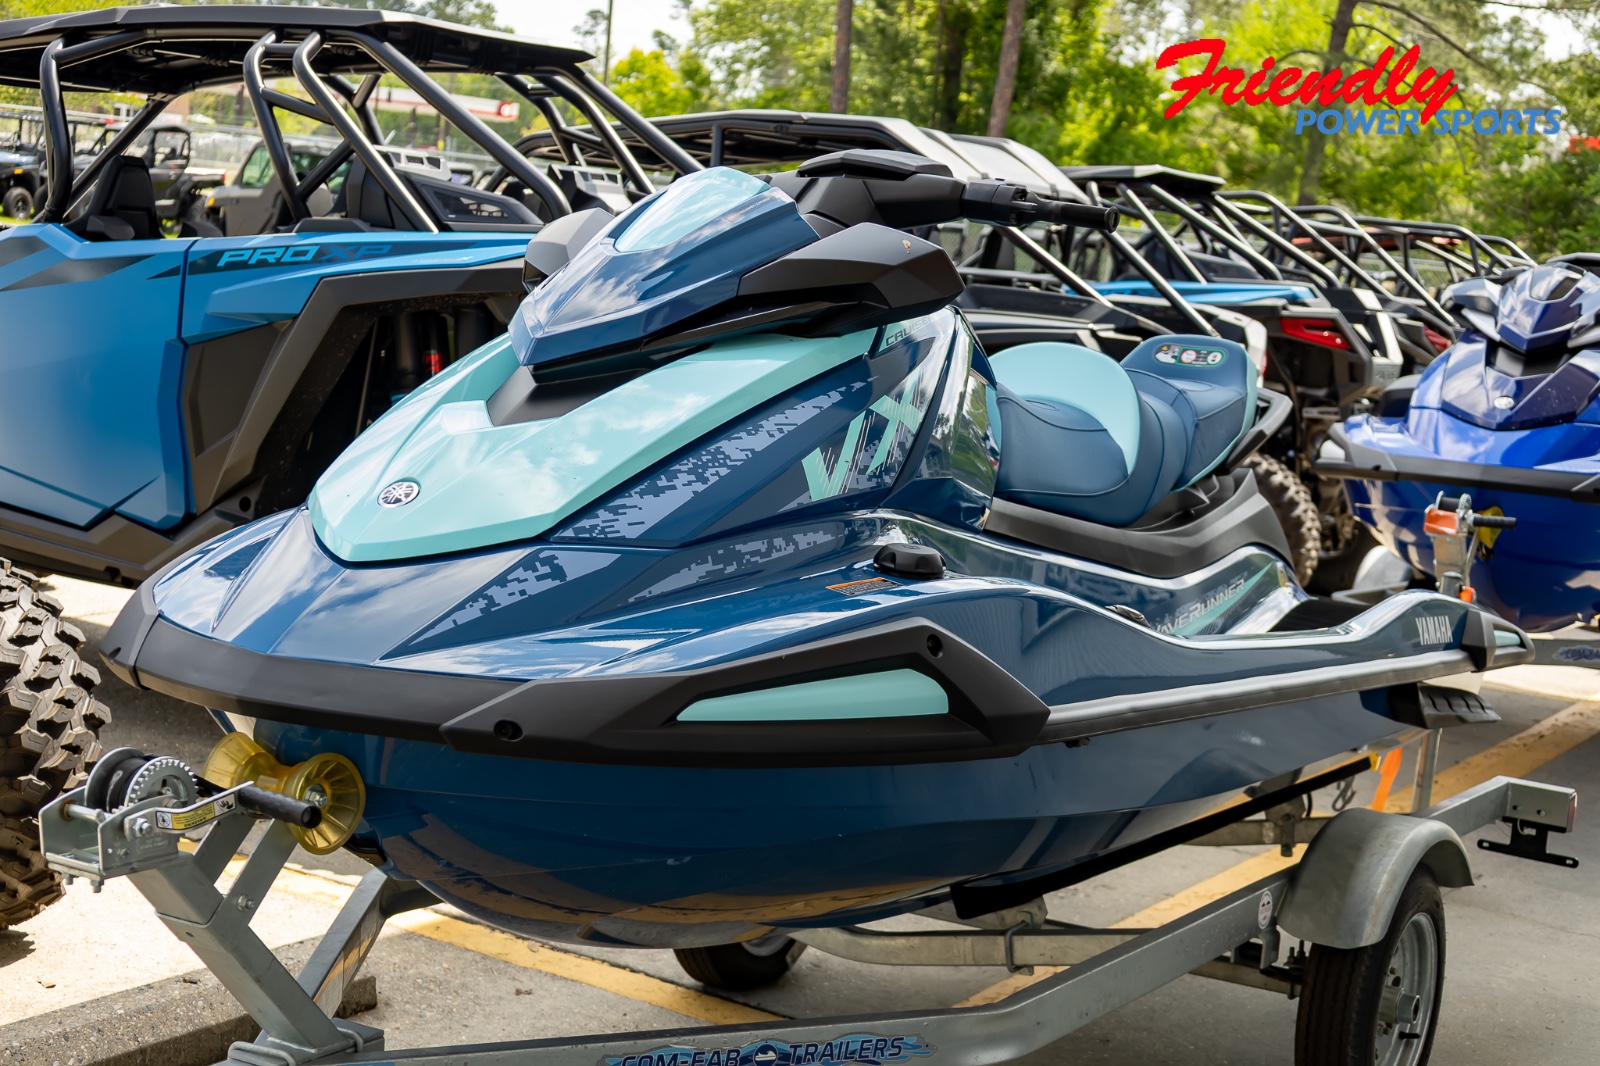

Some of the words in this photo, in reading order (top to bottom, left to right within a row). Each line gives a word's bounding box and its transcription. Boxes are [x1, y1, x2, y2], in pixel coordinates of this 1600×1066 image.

[217, 245, 320, 267] PRO
[318, 244, 392, 260] XP
[801, 367, 923, 502] VX
[1415, 615, 1453, 645] YAMAHA
[788, 1036, 905, 1065] TRAILERS
